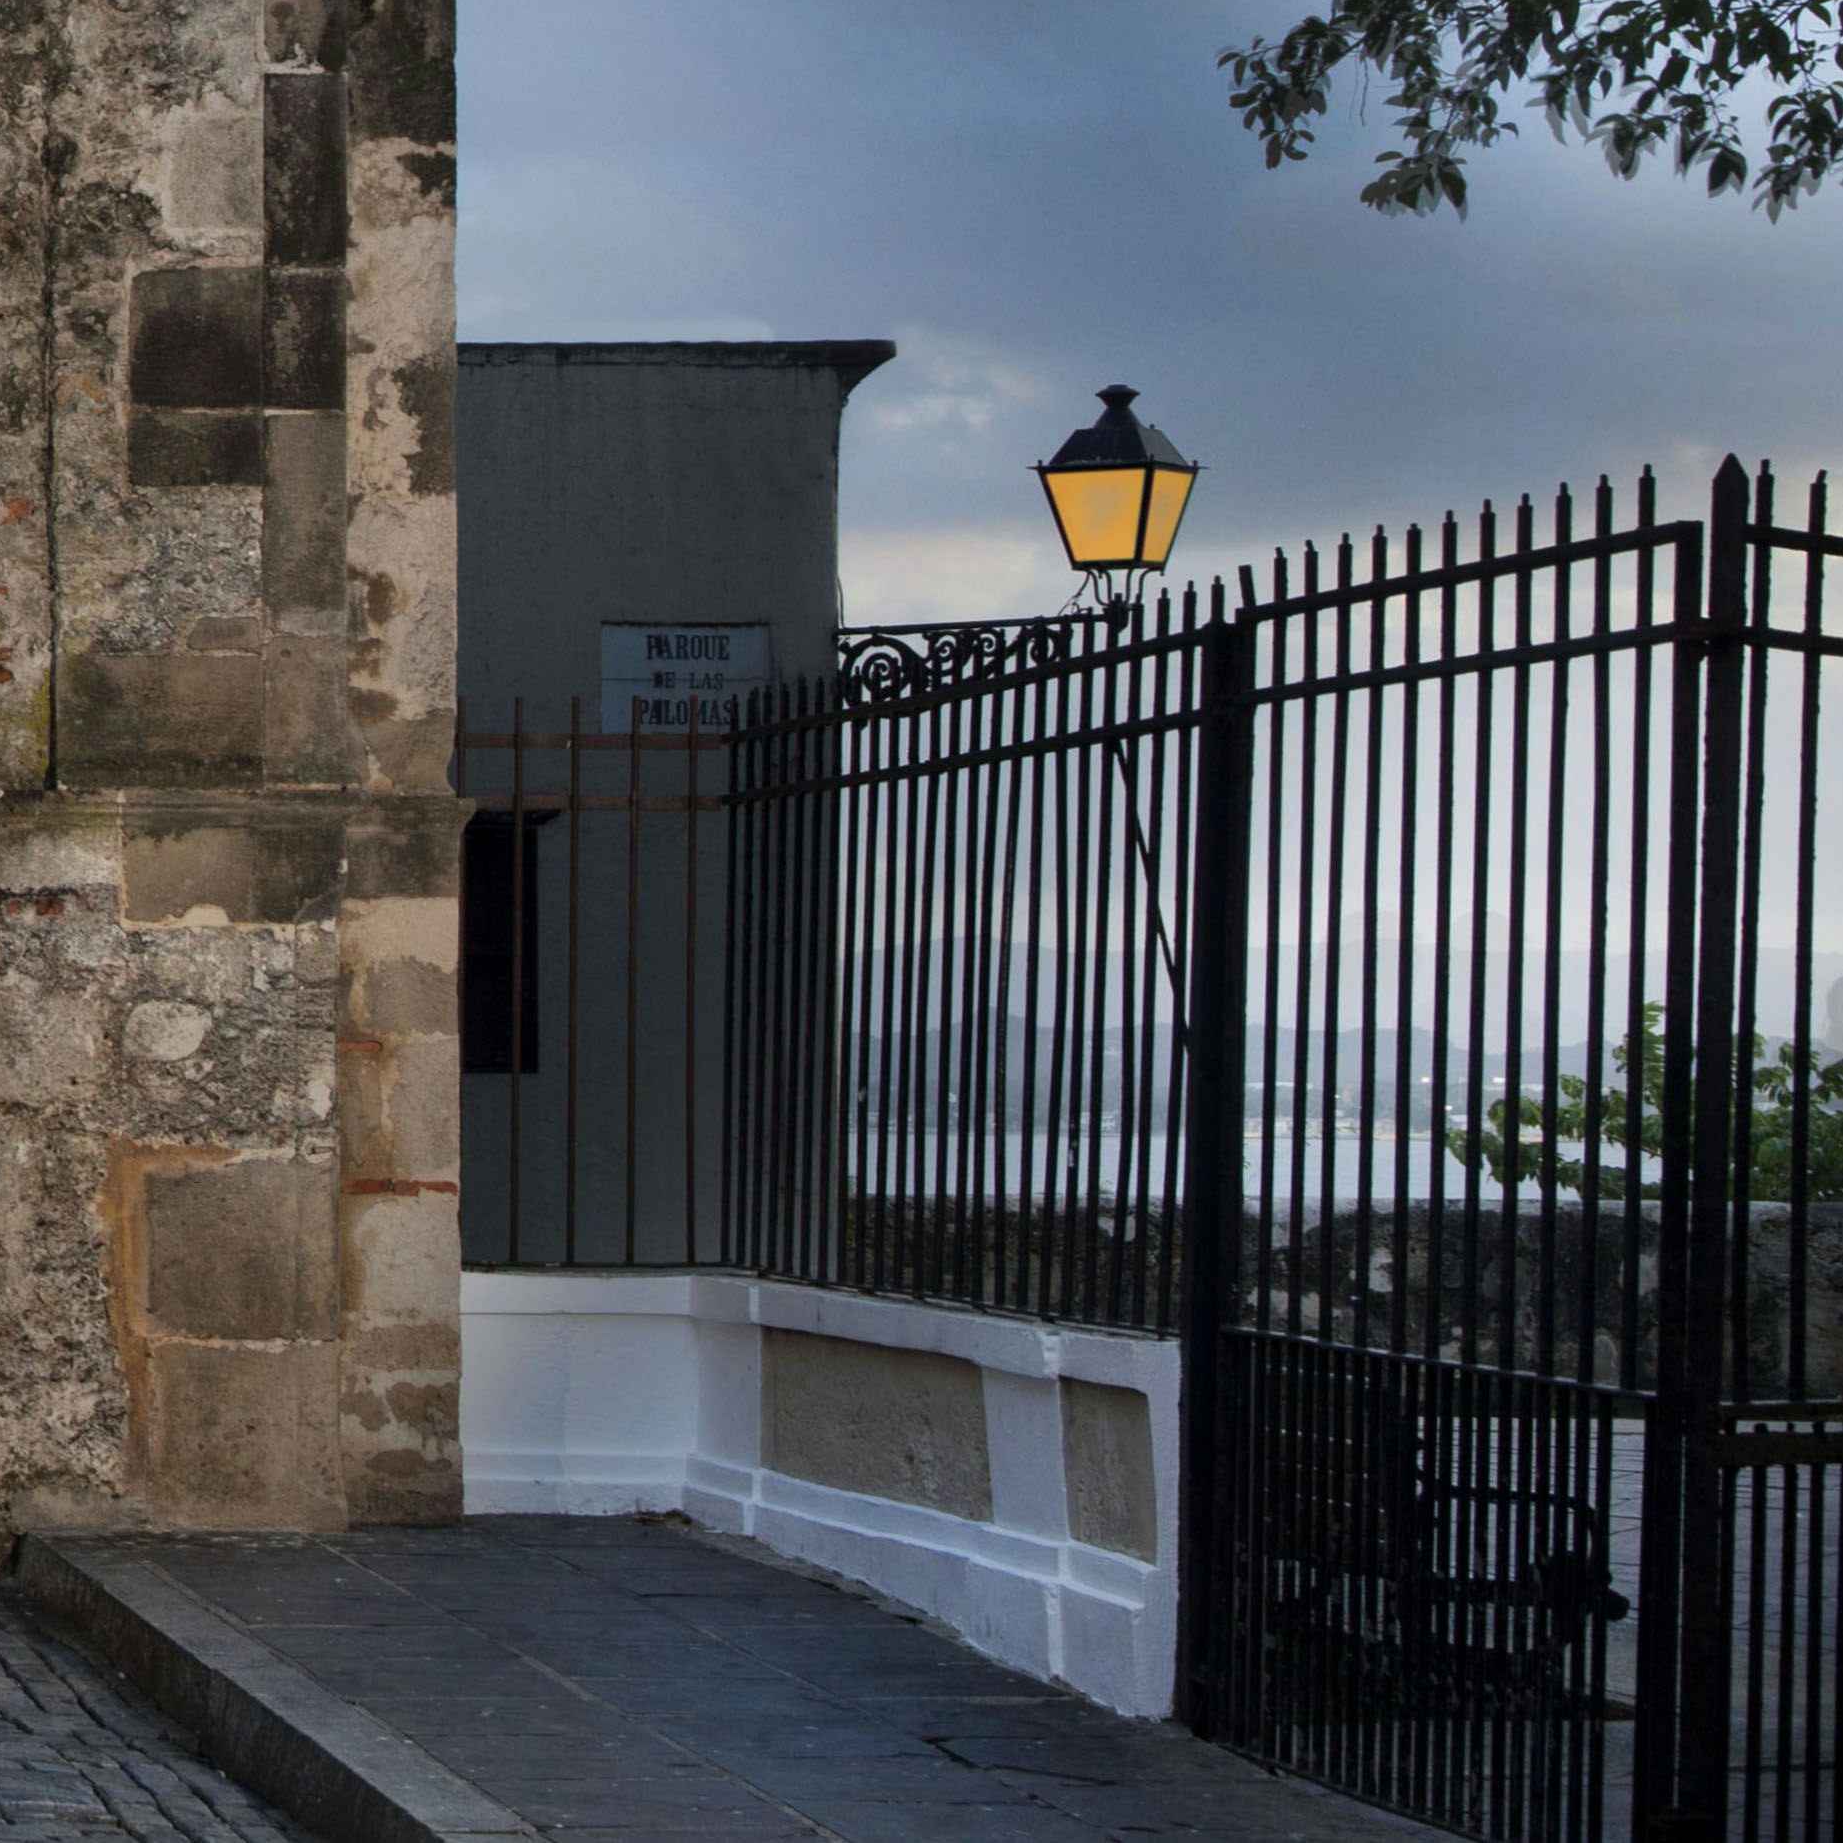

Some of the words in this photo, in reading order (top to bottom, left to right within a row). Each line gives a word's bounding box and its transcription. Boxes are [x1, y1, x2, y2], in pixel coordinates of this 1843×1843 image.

[646, 634, 730, 661] PARQUE
[652, 670, 676, 689] DE
[689, 672, 723, 690] LAS
